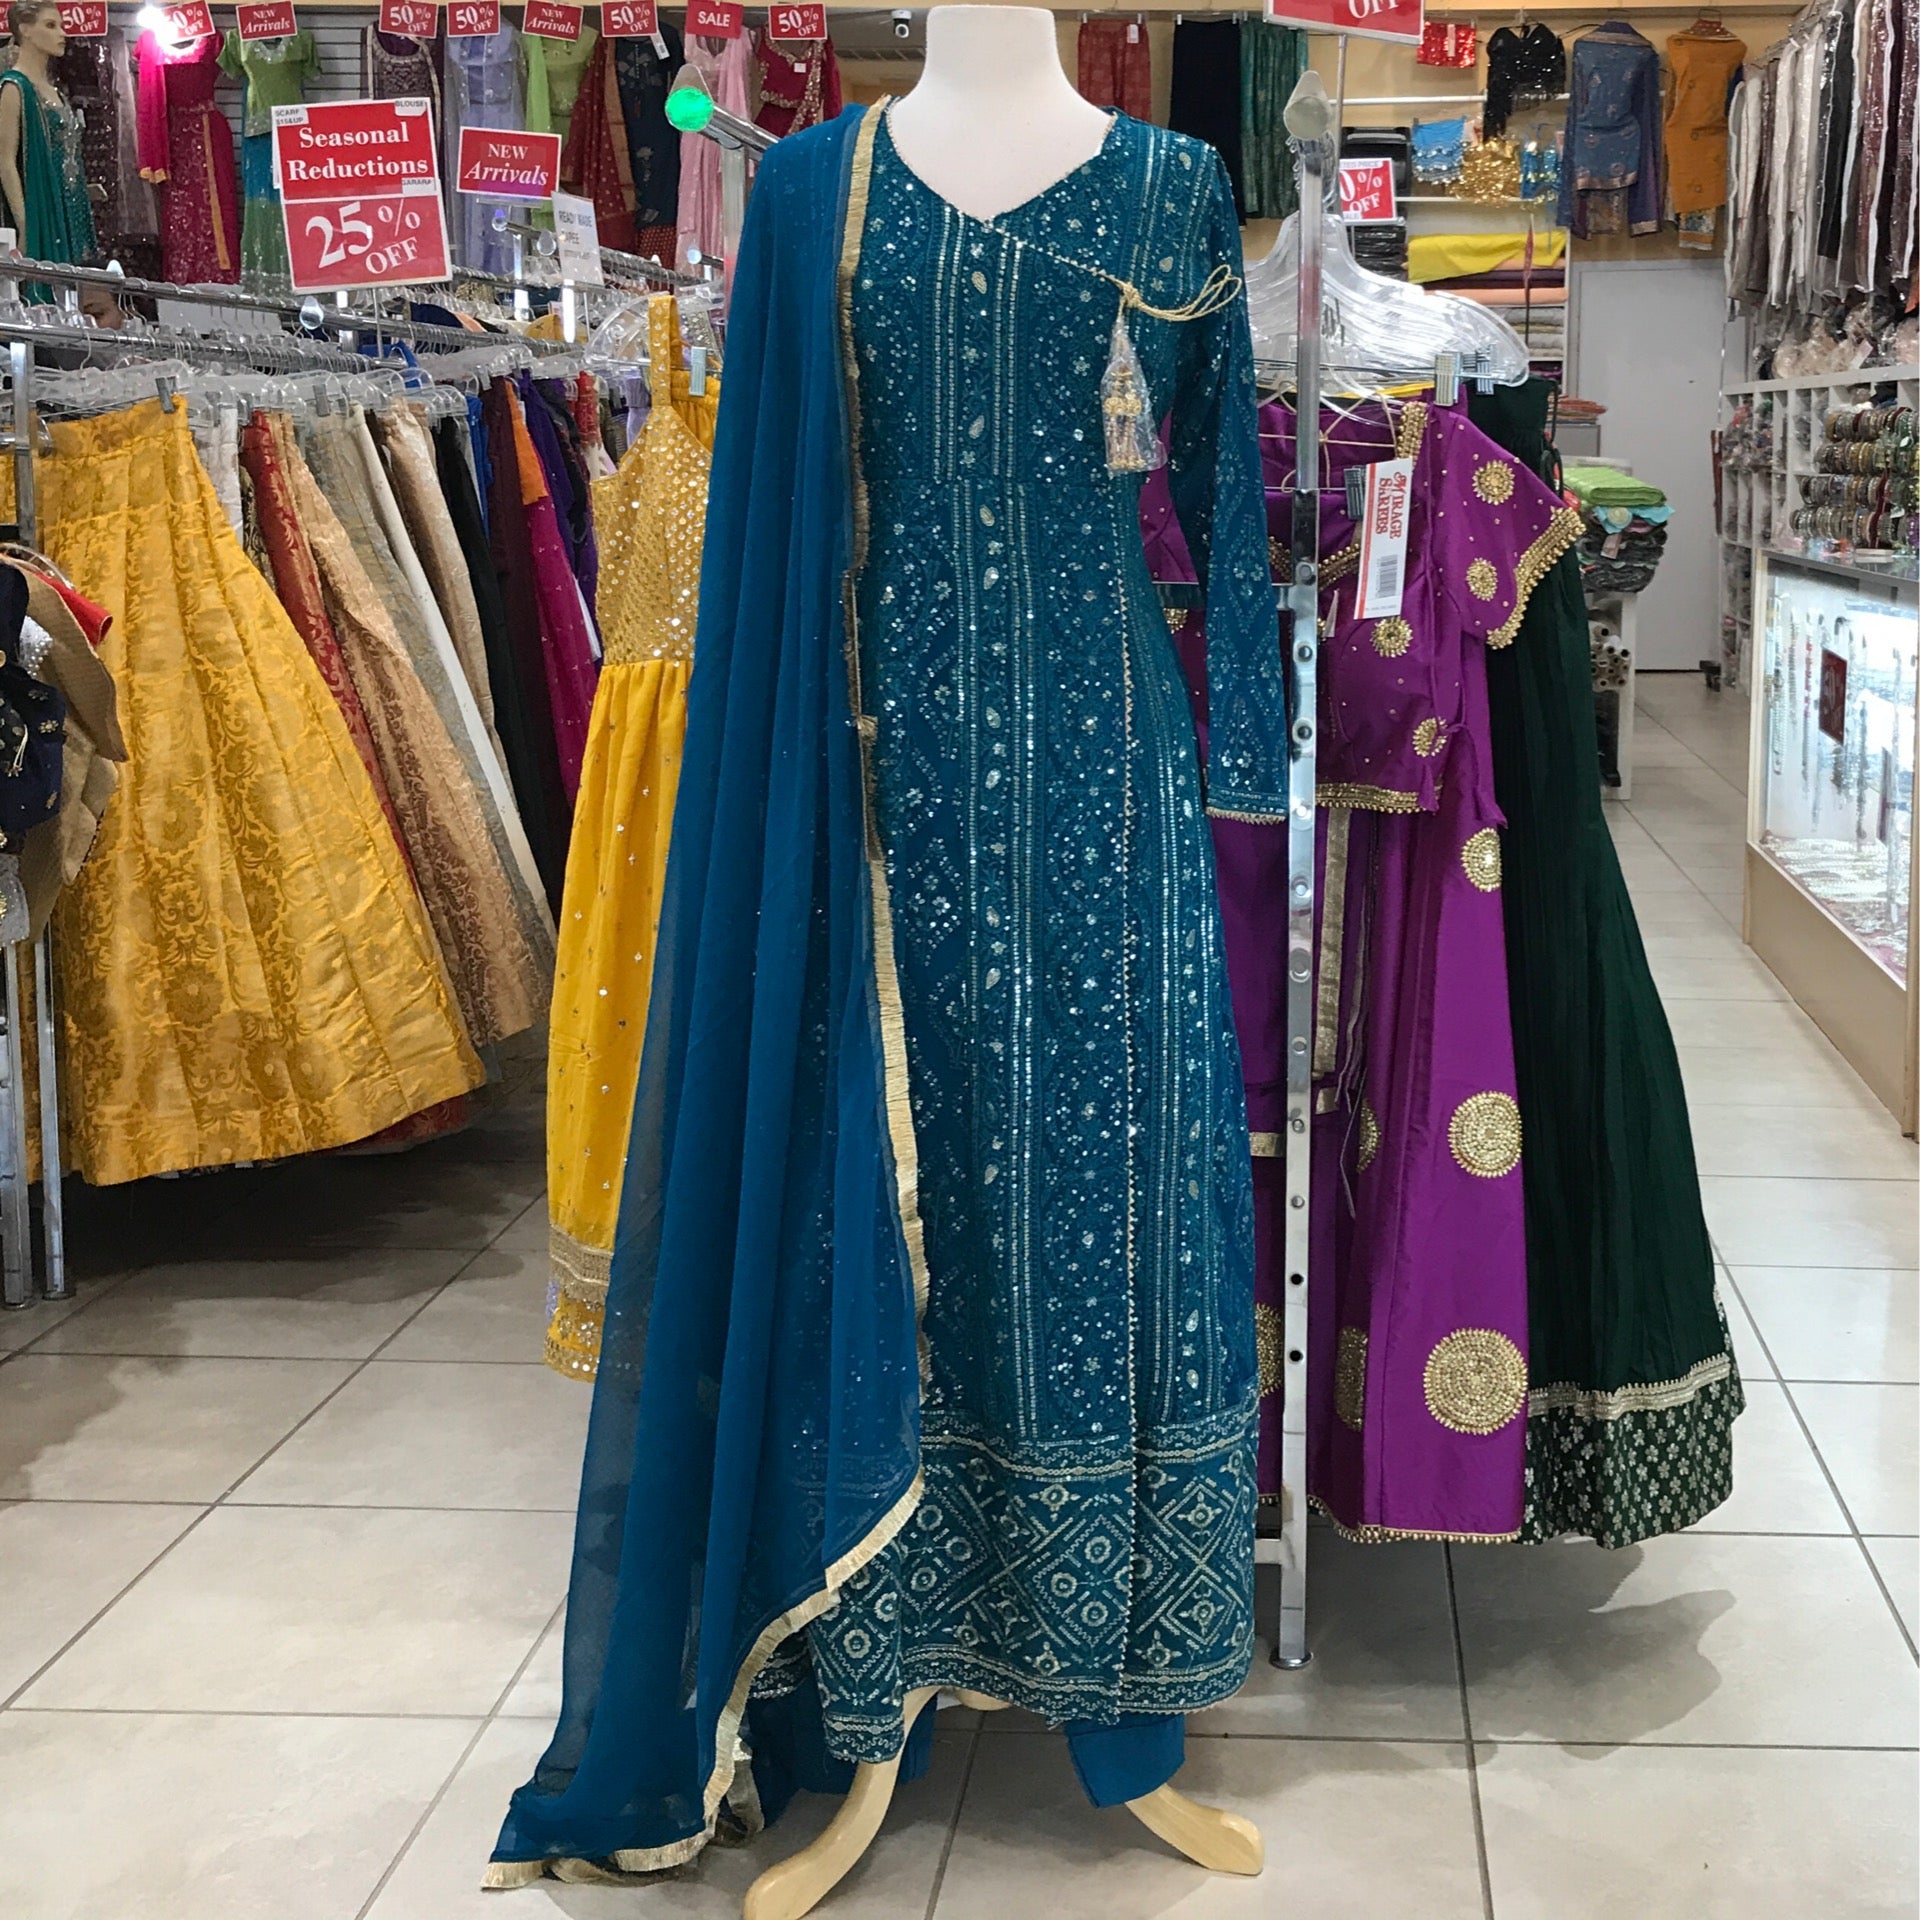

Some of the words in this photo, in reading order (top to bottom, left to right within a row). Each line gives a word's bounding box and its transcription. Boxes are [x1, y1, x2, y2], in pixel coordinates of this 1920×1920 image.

[252, 9, 277, 20] NEW
[540, 7, 565, 19] NEW
[697, 11, 730, 28] SALE
[80, 22, 101, 33] OFF
[243, 17, 291, 34] Arrivals
[407, 21, 428, 33] OFF
[472, 19, 493, 33] OFF
[527, 16, 575, 35] Arrivals
[629, 20, 649, 33] OFF
[798, 22, 818, 37] OFF
[299, 121, 409, 148] Seasonal
[488, 143, 528, 160] NEW
[286, 155, 429, 181] Reductions
[464, 160, 549, 186] Arrivals
[365, 236, 418, 274] OFF
[1376, 477, 1393, 534] SAREES
[1390, 471, 1407, 539] MIRAGE
